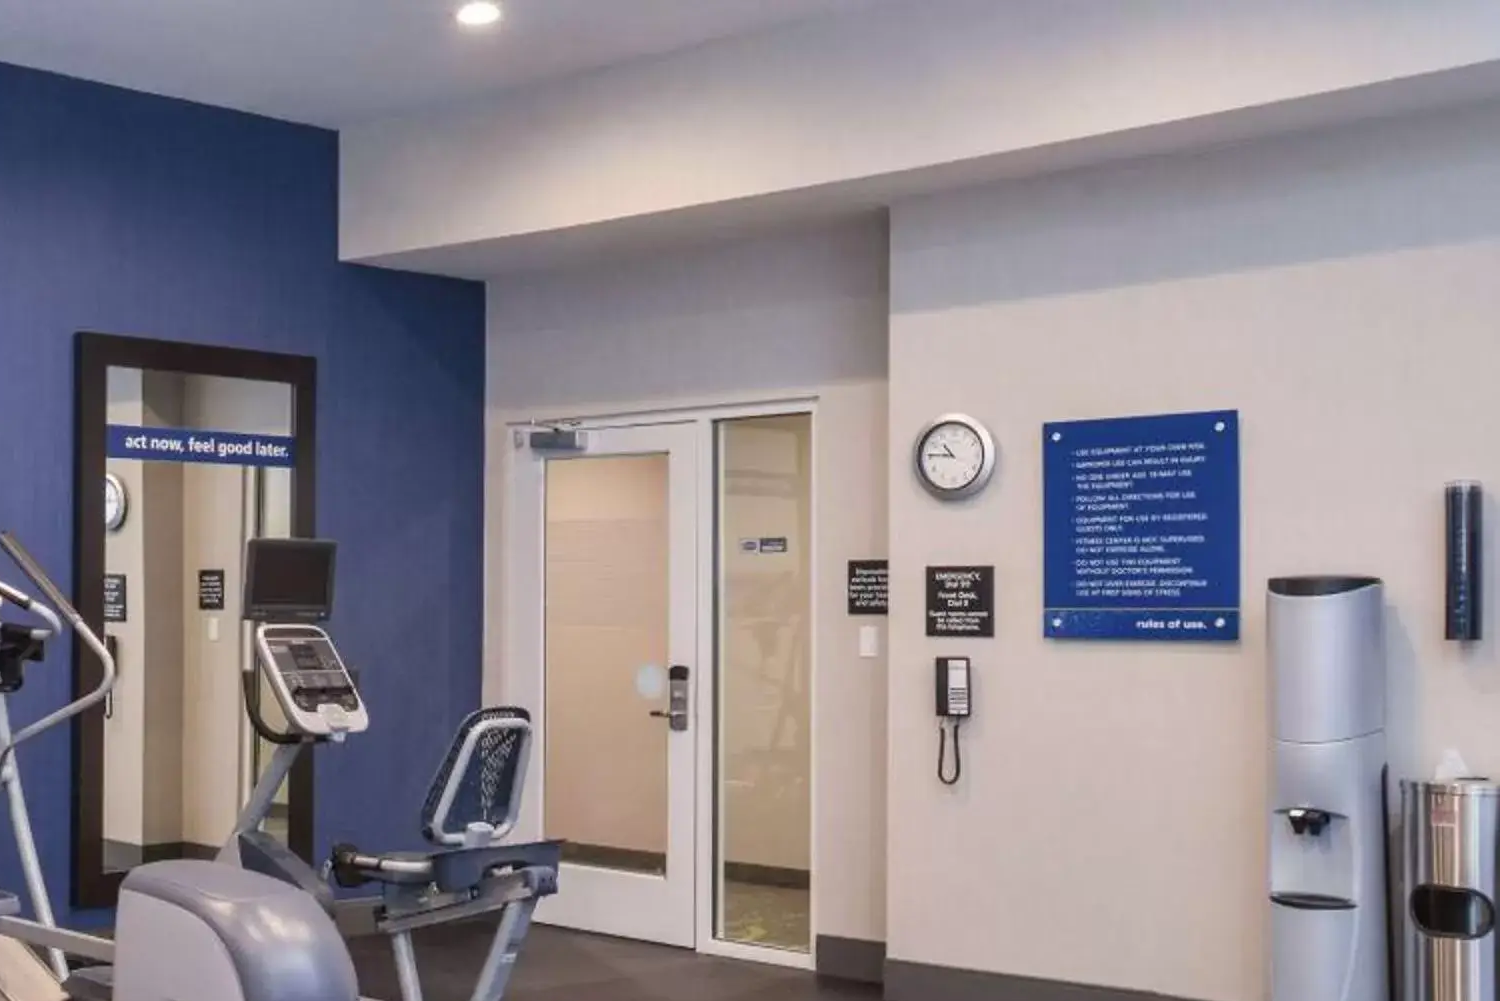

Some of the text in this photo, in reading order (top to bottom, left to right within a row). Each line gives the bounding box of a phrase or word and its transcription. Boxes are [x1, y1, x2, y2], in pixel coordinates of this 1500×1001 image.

[125, 436, 288, 458] act now, feel good later.
[1090, 446, 1131, 456] EQUIPMENT
[1105, 472, 1130, 480] UNDER
[1076, 495, 1106, 503] FOLLOW
[1121, 492, 1163, 501] DIRECTIONS
[1166, 491, 1180, 499] FOR
[1136, 619, 1165, 629] rules
[1168, 618, 1181, 629] of
